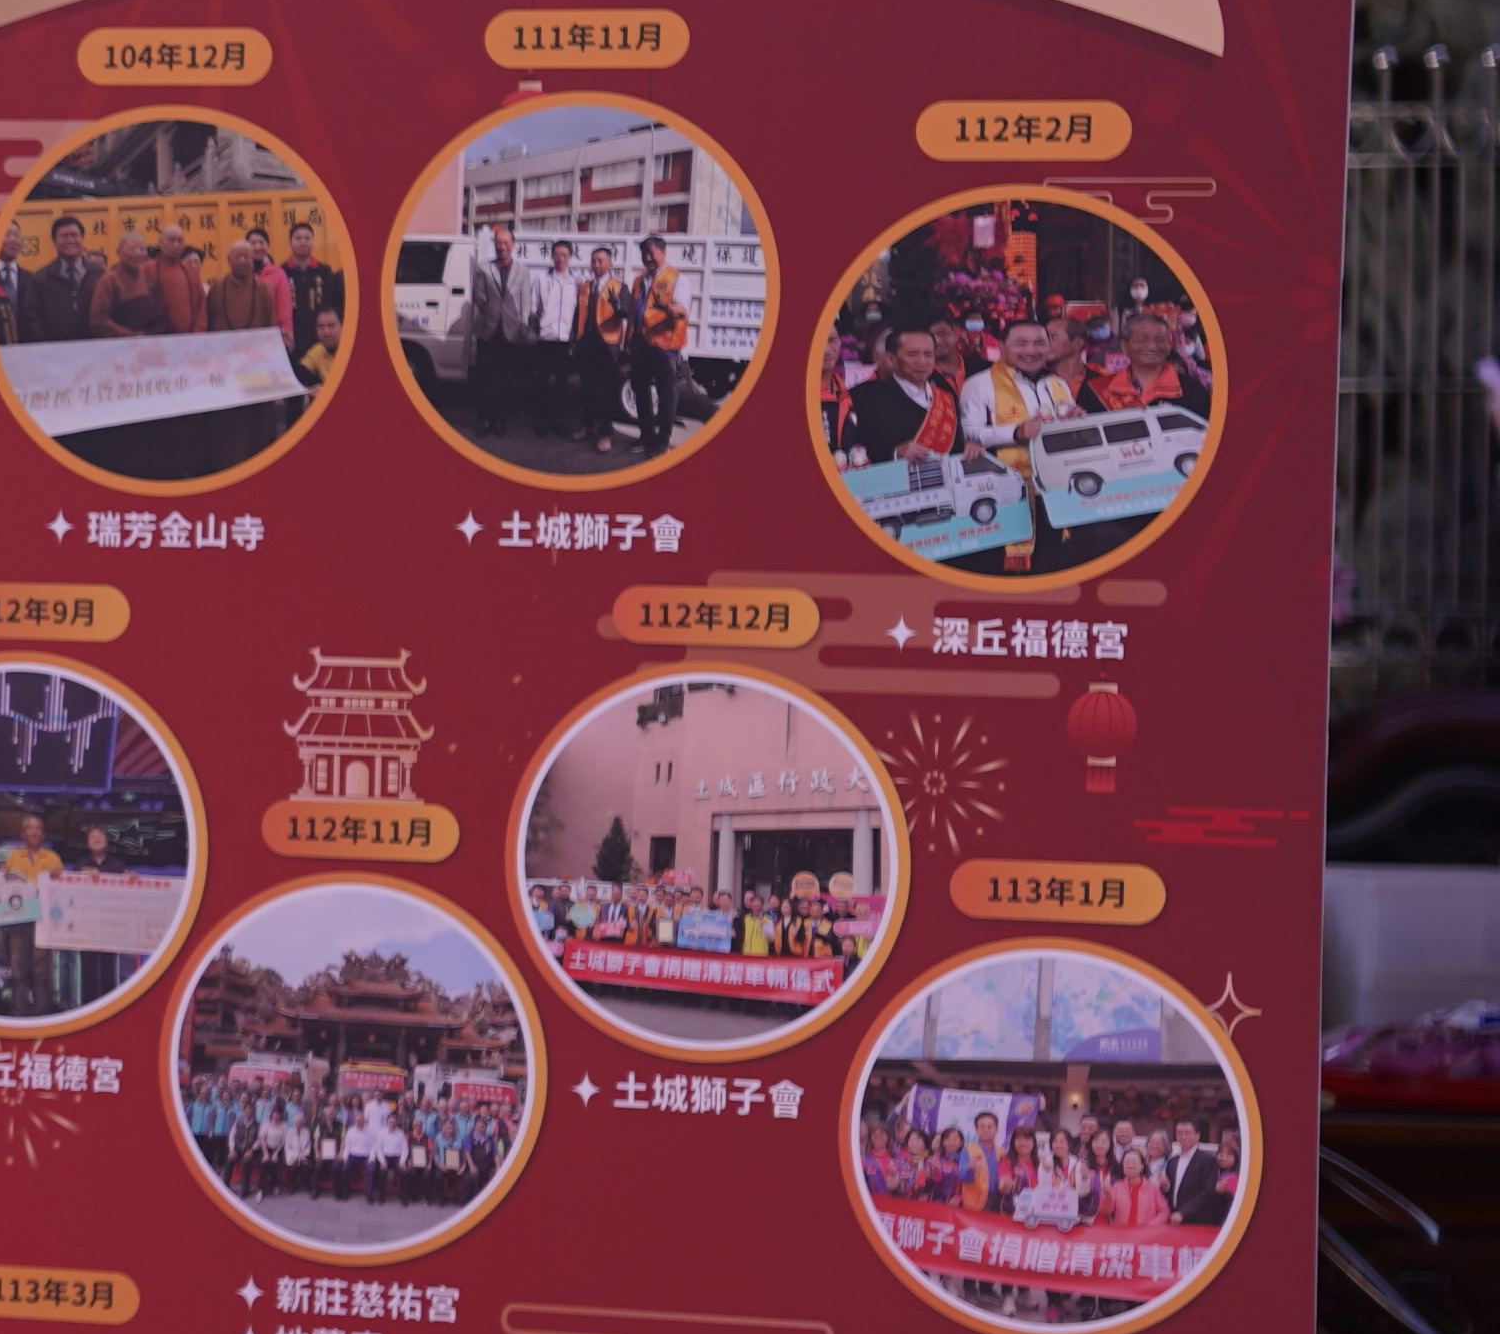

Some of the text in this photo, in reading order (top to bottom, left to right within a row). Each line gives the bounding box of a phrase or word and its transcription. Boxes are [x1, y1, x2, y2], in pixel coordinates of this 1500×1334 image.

[512, 23, 663, 53] 111年11月
[103, 42, 247, 72] 104年12月
[954, 114, 1094, 144] 112年2月
[87, 510, 266, 553] 瑞芳金山寺
[498, 509, 685, 553] 土城獅子會
[638, 601, 791, 633] 112年12月
[932, 617, 1129, 660] 深丘福德宮
[286, 815, 432, 847] 112年11月
[987, 876, 1126, 909] 113年1月
[612, 1070, 804, 1120] 土城獅子會
[275, 1275, 461, 1324] 新莊慈祐宮
